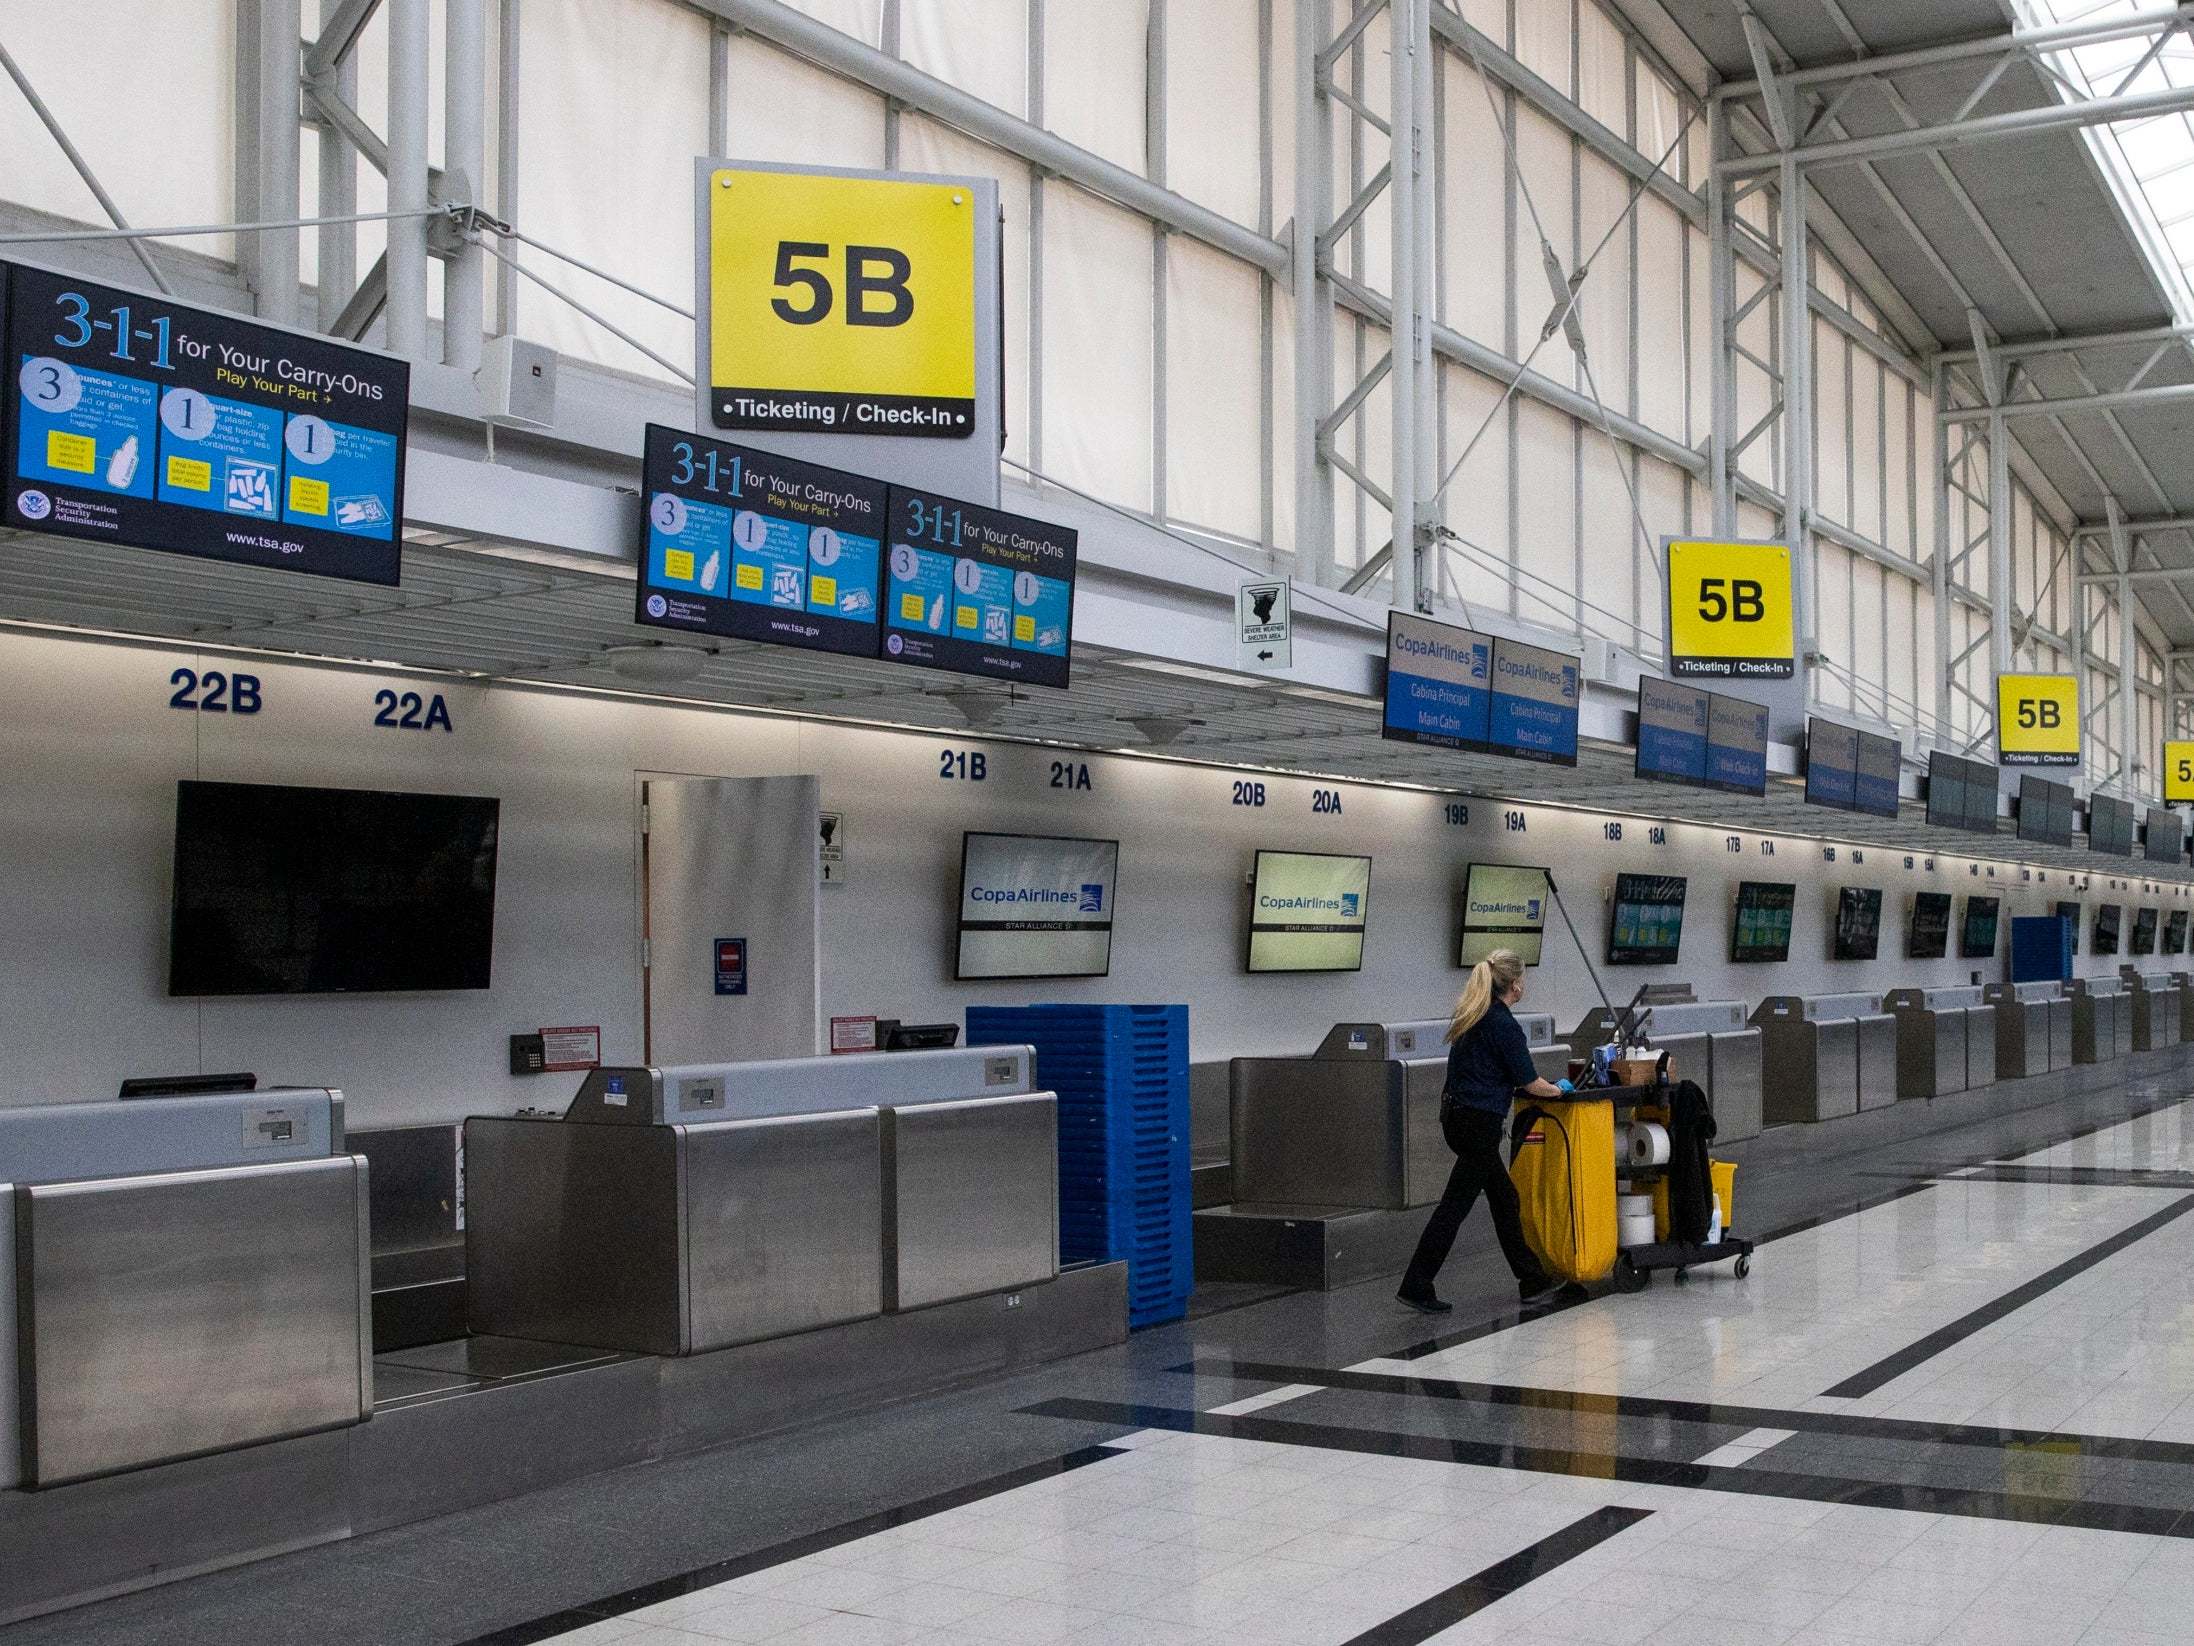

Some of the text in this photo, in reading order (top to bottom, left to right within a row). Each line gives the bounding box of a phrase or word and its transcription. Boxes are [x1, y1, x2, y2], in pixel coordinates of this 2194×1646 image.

[771, 241, 914, 327] 5B
[54, 292, 384, 401] 3-1-1 for Your Carry-Ons
[38, 366, 61, 400] 3
[132, 384, 151, 396] less
[216, 368, 318, 404] Play Your Part
[181, 398, 193, 429] 1
[736, 398, 951, 426] Ticketing / Check-In
[216, 423, 232, 434] bag
[304, 424, 316, 454] 1
[672, 442, 872, 513] 3-1-1 for Your Carry-Ons
[55, 496, 118, 514] Transportation
[55, 504, 91, 518] Security
[662, 500, 674, 526] 3
[767, 492, 830, 516] Play Your Part
[55, 513, 118, 530] Administration
[746, 518, 752, 542] 1
[906, 498, 1064, 559] 3-1-1 for Your Carry-Ons
[226, 532, 304, 555] www.tsa.gov
[822, 534, 827, 558] 1
[981, 544, 998, 557] Play
[1000, 548, 1014, 559] Your
[899, 550, 910, 574] 3
[965, 564, 970, 587] 1
[1024, 578, 1030, 599] 1
[1698, 578, 1765, 623] 5B
[771, 620, 820, 636] www.tsa.gov
[1396, 633, 1470, 666] CopaAirlines
[1498, 657, 1561, 685] CopaAirlines
[1684, 660, 1730, 674] Ticketing
[1739, 662, 1784, 674] Check-In
[170, 668, 262, 714] 22B
[1411, 682, 1470, 708] Cabina Principal
[374, 689, 453, 733] 22A
[1418, 711, 1460, 730] Main Cabin
[2016, 699, 2062, 729] 5B
[1516, 728, 1532, 742] Main
[940, 750, 987, 781] 21B
[2008, 754, 2038, 764] Ticketing
[1050, 761, 1092, 790] 21A
[2178, 760, 2194, 782] 5
[1232, 780, 1266, 807] 20B
[1312, 790, 1342, 814] 20A
[1444, 804, 1468, 826] 19B
[1504, 811, 1526, 832] 19A
[1604, 822, 1622, 841] 18B
[1648, 827, 1666, 845] 18A
[1726, 836, 1741, 853] 17B
[1761, 840, 1775, 856] 17A
[1823, 847, 1836, 862] 16B
[1852, 850, 1864, 865] 16A
[1904, 856, 1914, 870] 15B
[970, 886, 1078, 905] CopaAirlines
[1260, 895, 1340, 910] CopaAirlines
[1470, 900, 1526, 915] CopaAirlines
[1006, 922, 1063, 930] STAR ALLIANCE
